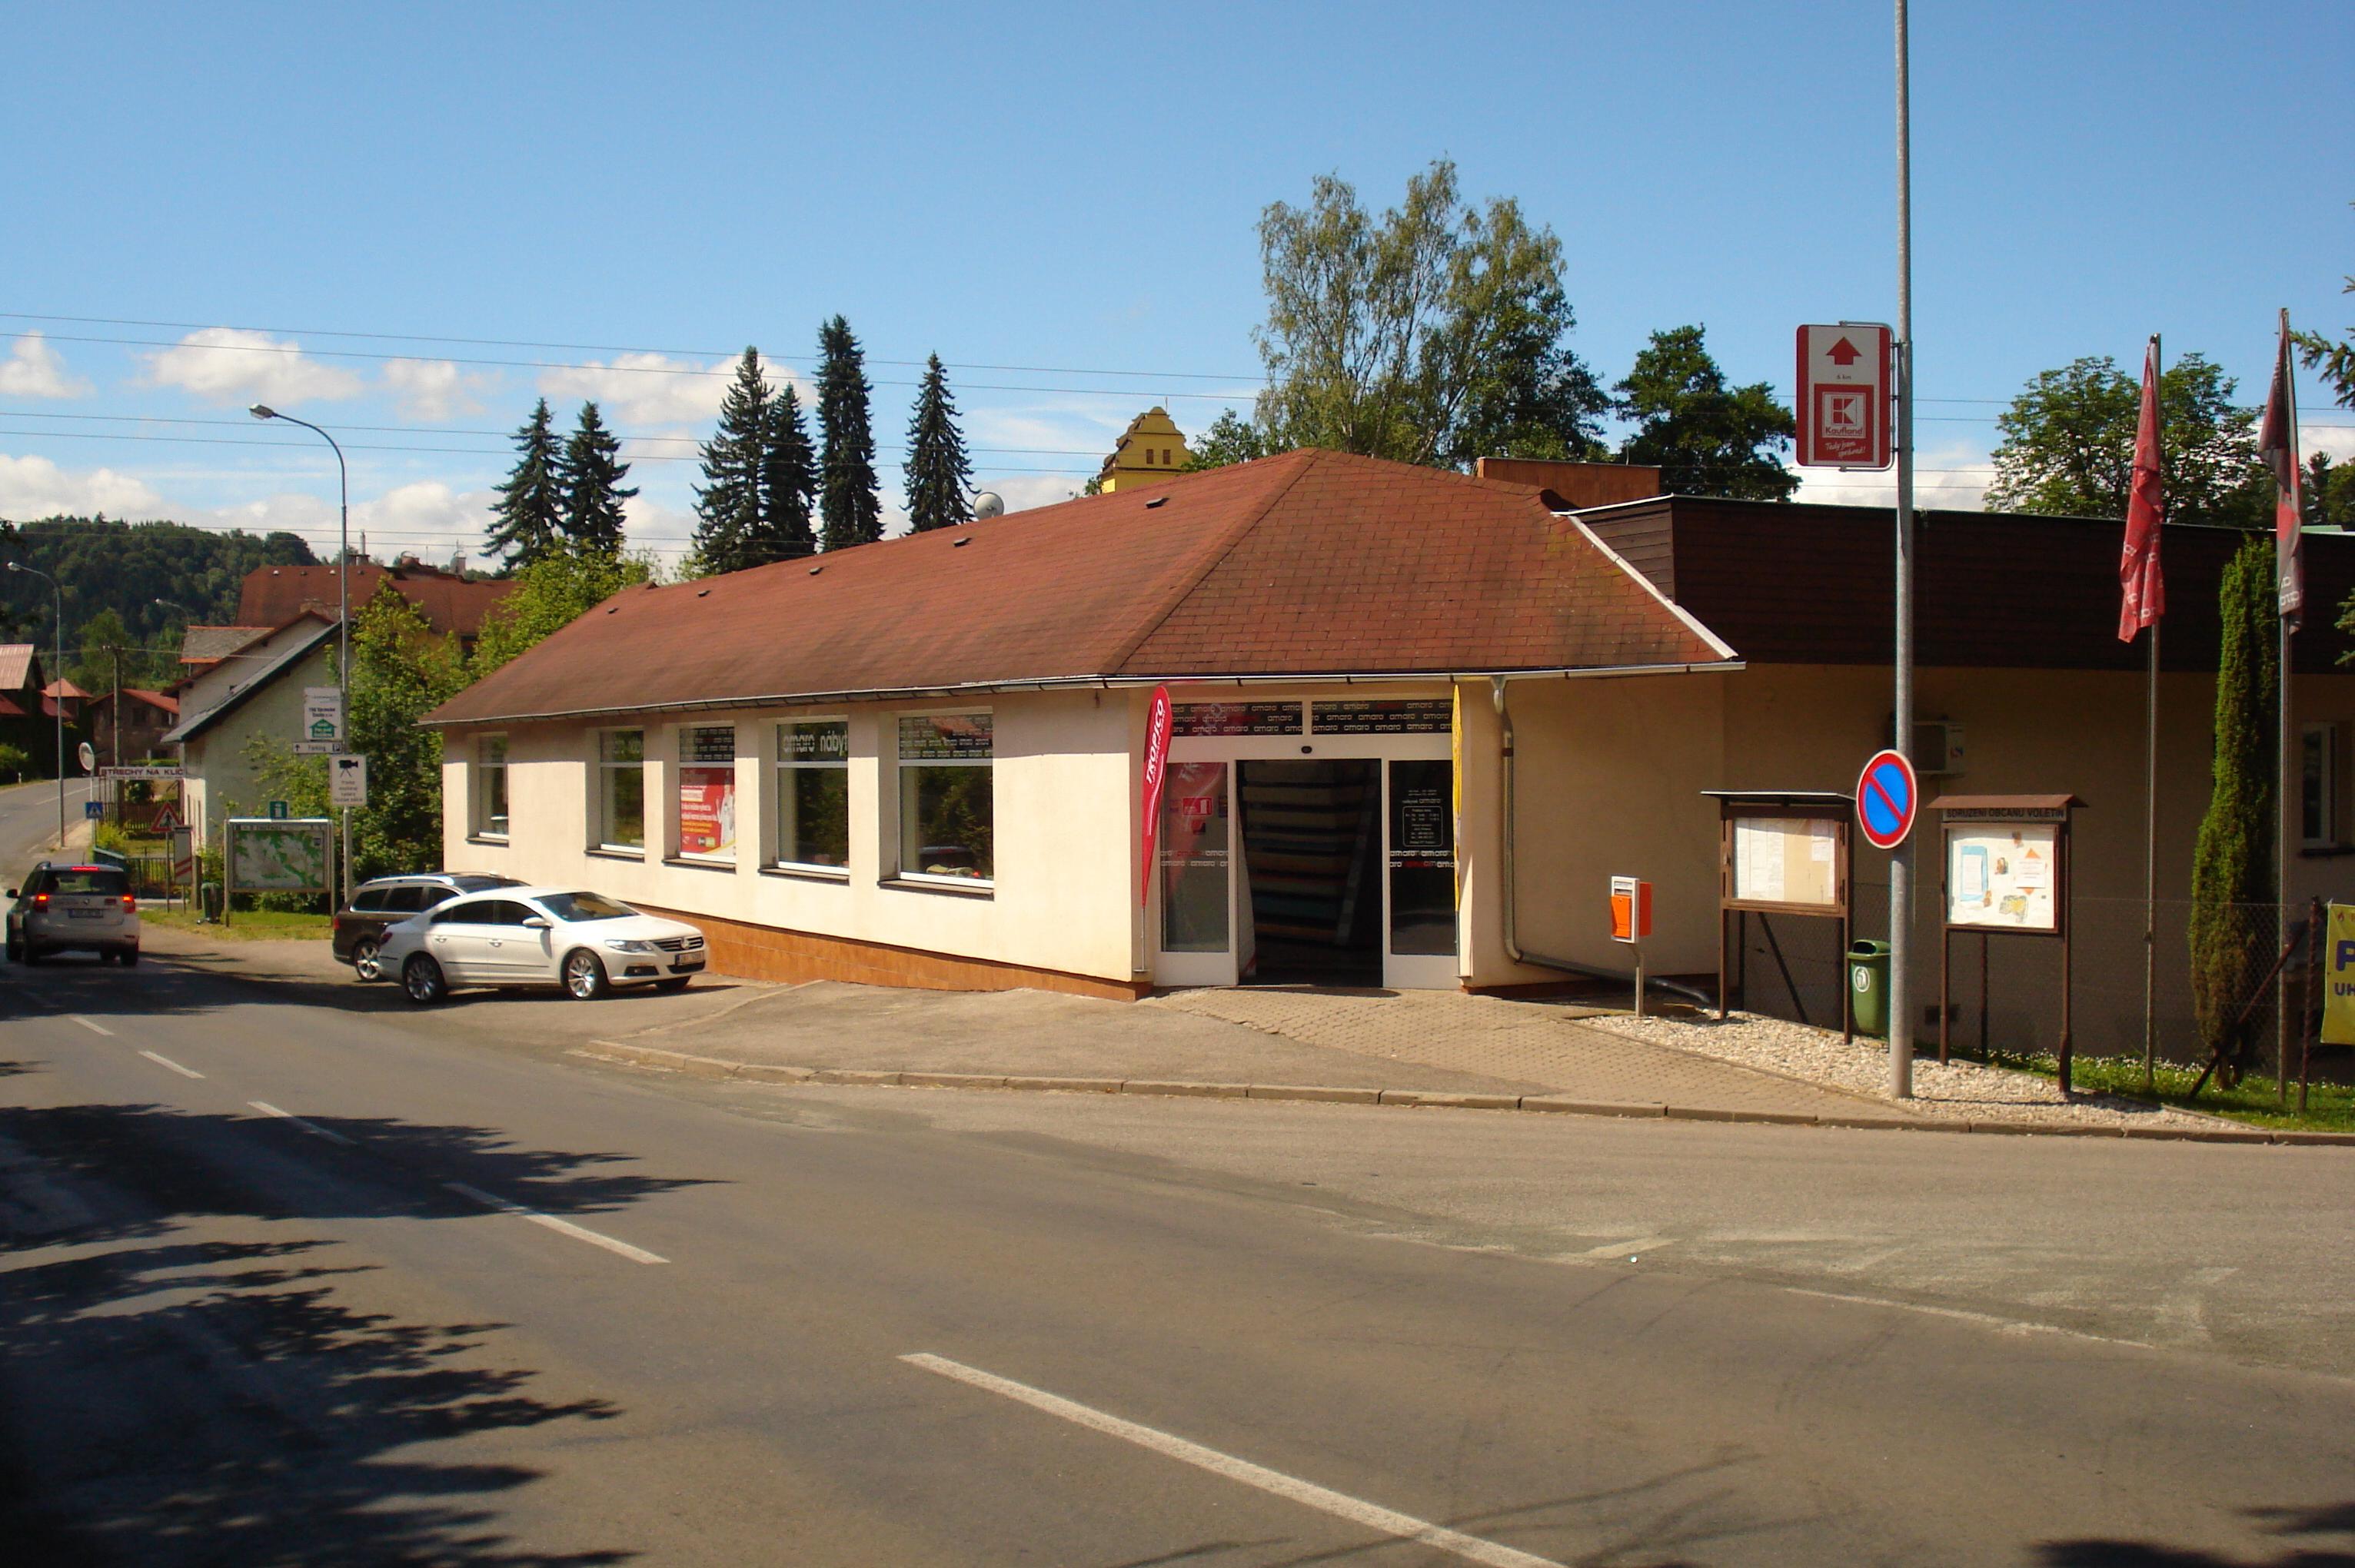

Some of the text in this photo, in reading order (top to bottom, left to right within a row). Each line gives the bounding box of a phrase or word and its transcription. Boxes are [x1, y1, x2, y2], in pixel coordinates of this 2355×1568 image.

[1825, 426, 1864, 435] Kaufland
[783, 734, 815, 753] amaro
[1146, 699, 1163, 784] TROPICO
